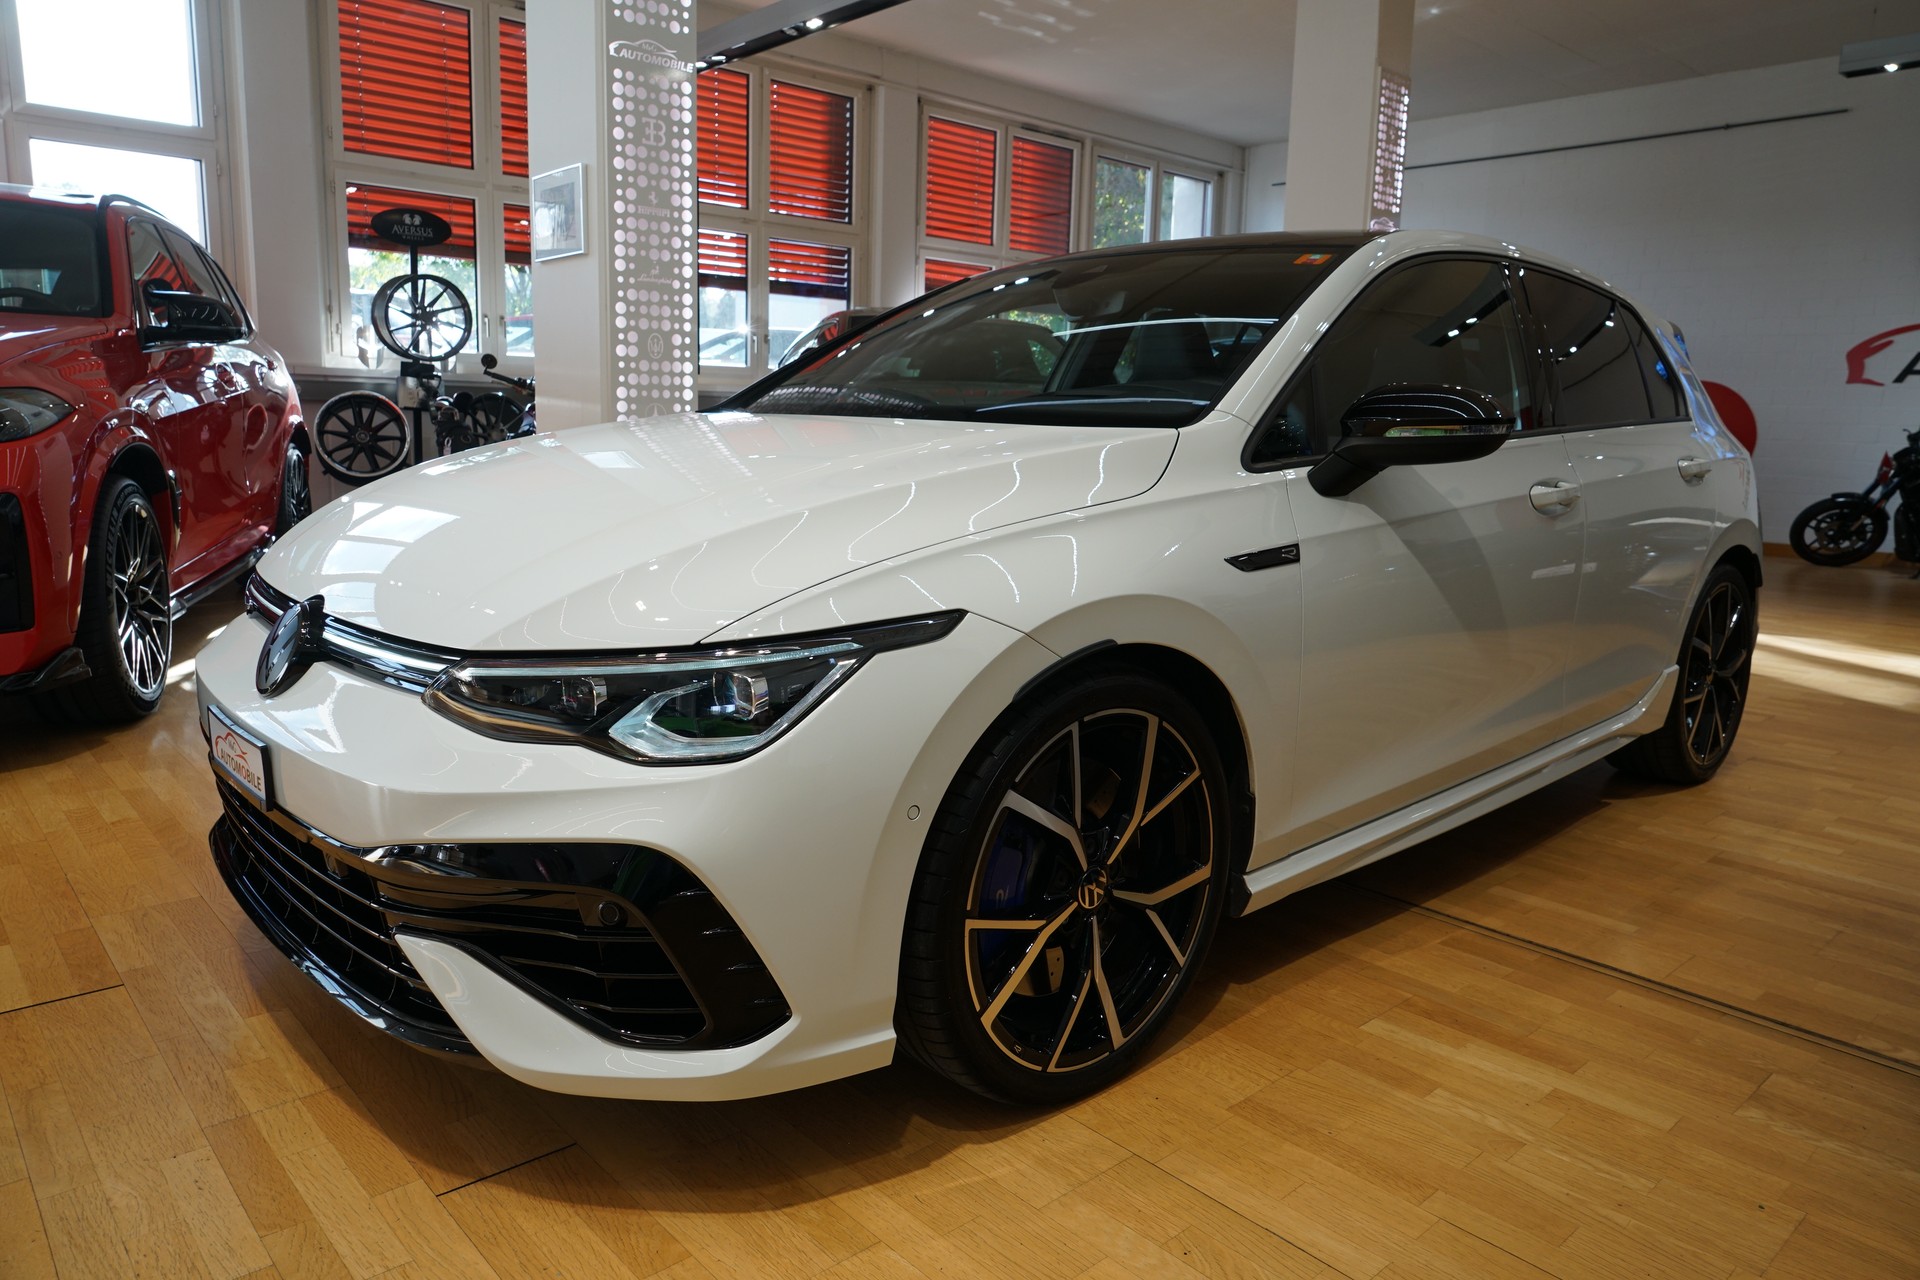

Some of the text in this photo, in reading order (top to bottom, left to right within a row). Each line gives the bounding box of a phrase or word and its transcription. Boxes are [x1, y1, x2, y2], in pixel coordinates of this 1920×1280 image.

[620, 48, 694, 73] AUTOMOBILE
[391, 224, 433, 238] AVERSUS
[219, 748, 263, 792] AUTOMOBILE
